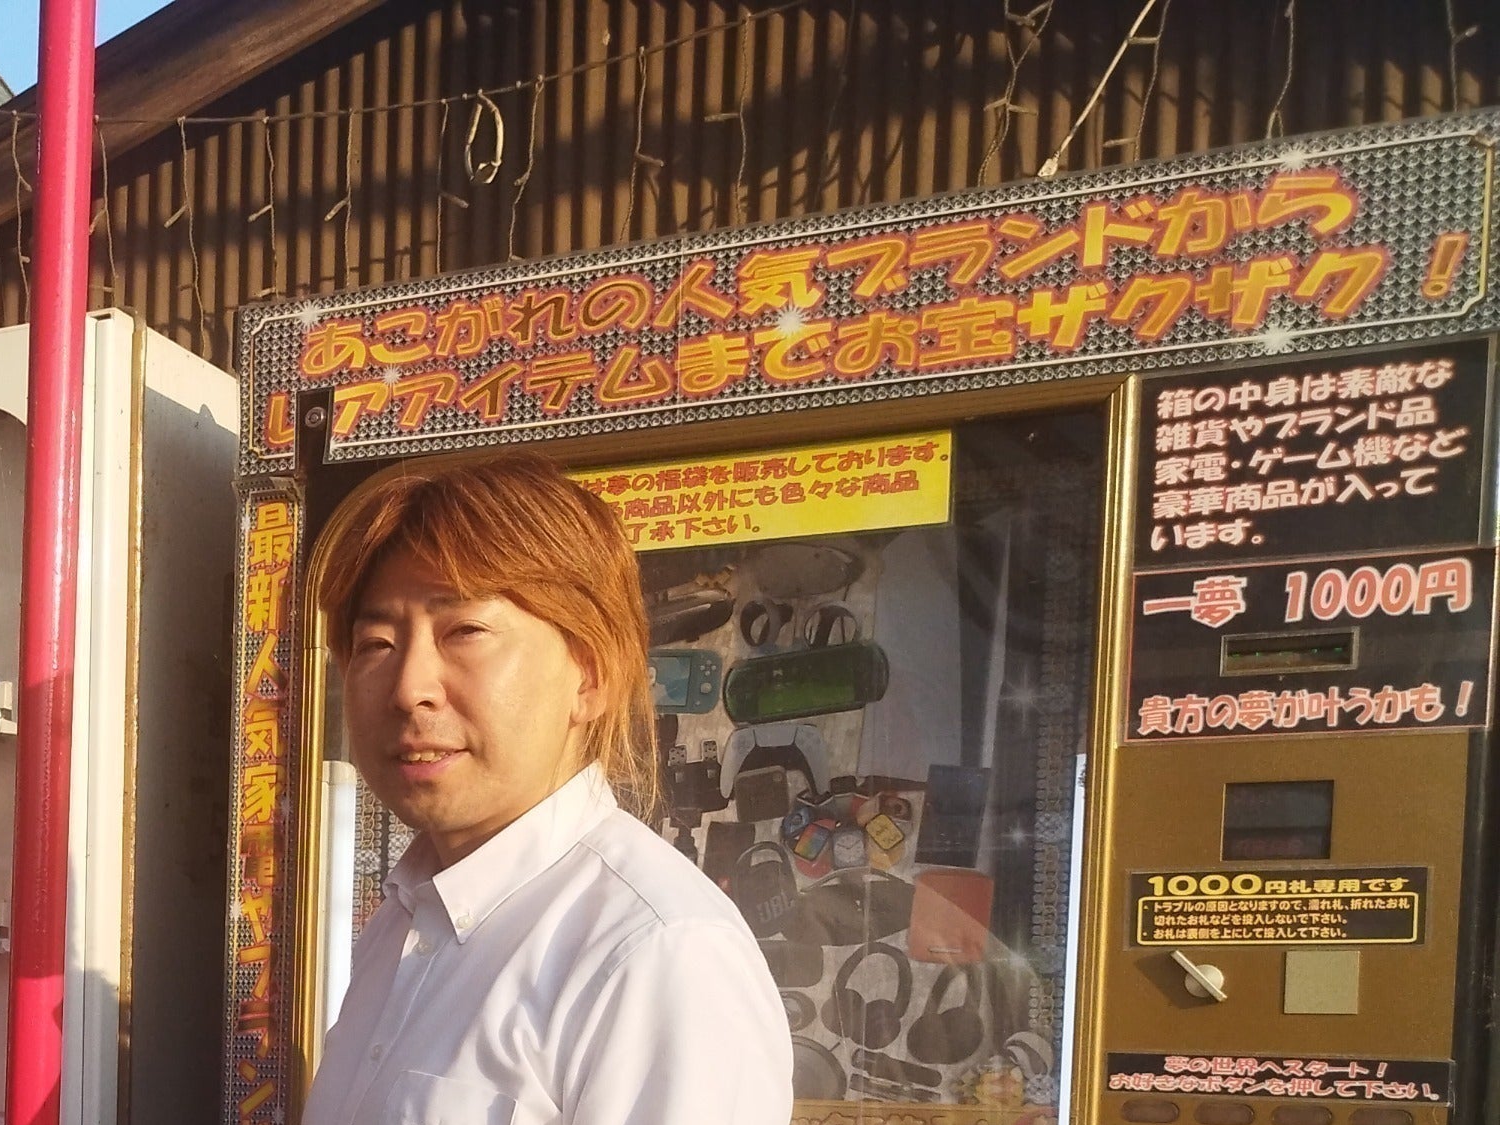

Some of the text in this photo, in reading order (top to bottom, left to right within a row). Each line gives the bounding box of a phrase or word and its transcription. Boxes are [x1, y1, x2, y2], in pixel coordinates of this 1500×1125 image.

[300, 170, 1360, 380] あこがれの人気ブランドから
[1156, 359, 1454, 420] 箱の中身は素敵な
[1155, 396, 1437, 451] 雑貨やブランド品
[580, 441, 950, 496] は夢の福袋を販売しております。
[1154, 426, 1468, 486] 家電・ゲーム機など
[1153, 467, 1438, 519] 豪華商品が入って
[1151, 518, 1265, 552] います。
[1285, 558, 1472, 623] 1000円
[1137, 681, 1474, 735] 貴方の夢が叶うかも！
[1147, 874, 1409, 896] 1000円札専用です
[1109, 1073, 1439, 1101] お好きなボタンを押して下さい。
[1164, 1055, 1388, 1079] 夢の世界へスタート！
